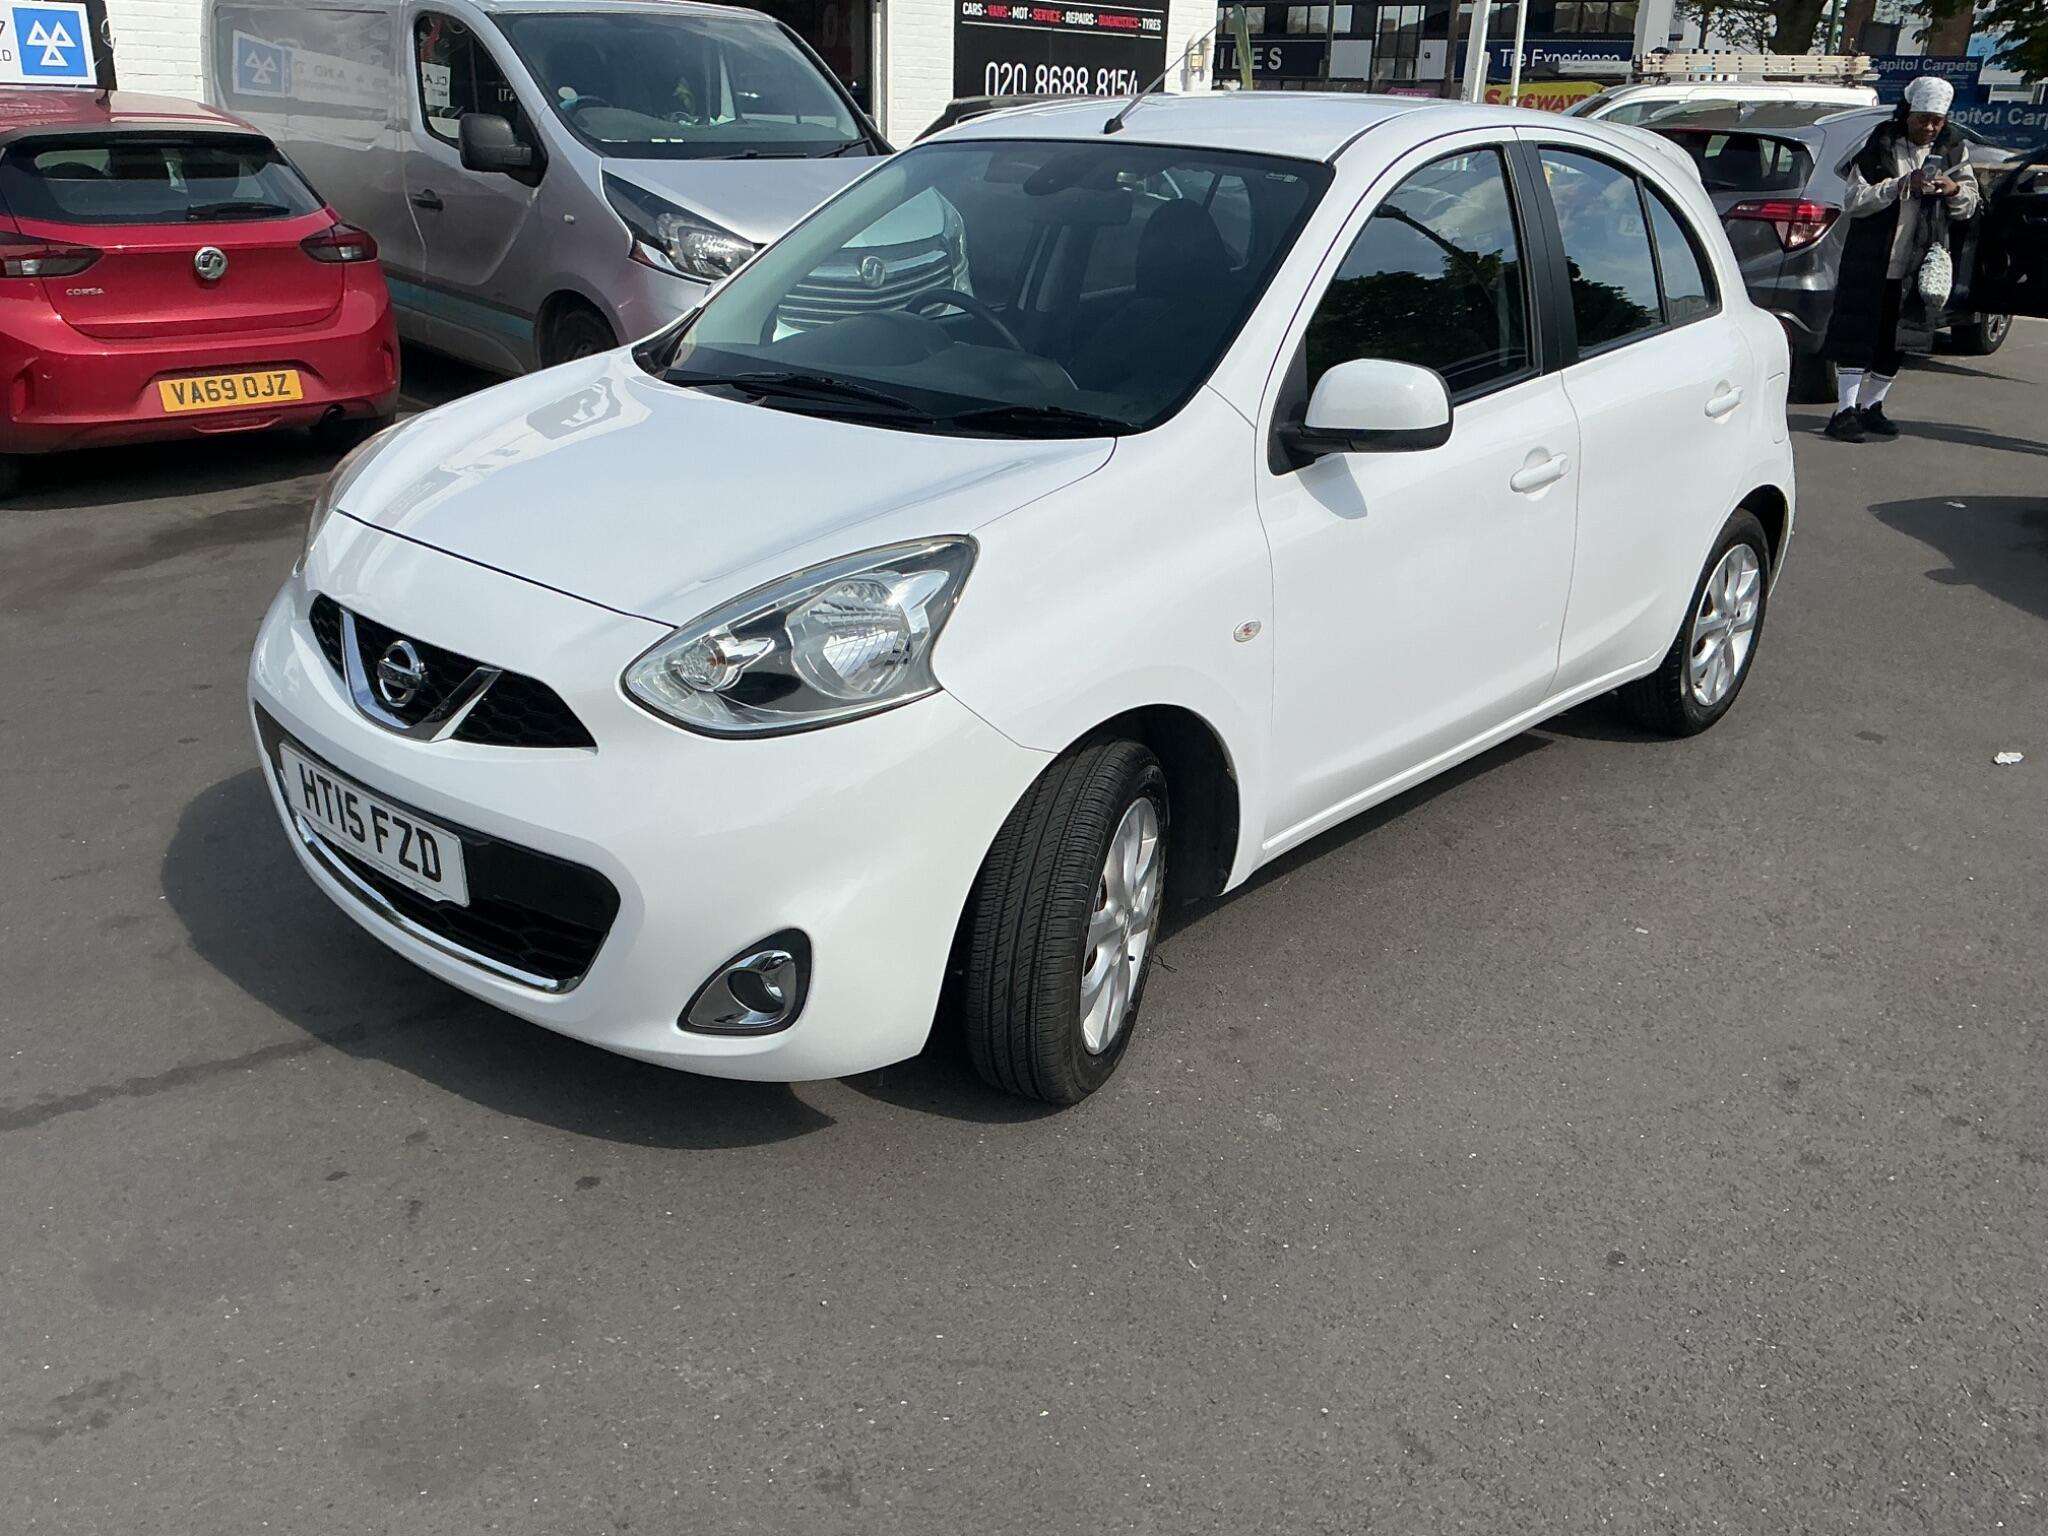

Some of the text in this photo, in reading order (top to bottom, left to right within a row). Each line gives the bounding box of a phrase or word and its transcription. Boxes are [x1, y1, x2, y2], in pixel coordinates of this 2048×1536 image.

[962, 3, 983, 16] CARS
[1012, 7, 1029, 20] MOT
[1033, 8, 1062, 22] SERVICE
[1065, 11, 1094, 25] REPAIRS
[1142, 18, 1162, 31] TYRES
[985, 61, 1138, 96] 020 8688 8154
[1922, 59, 1978, 74] Carpets
[1947, 107, 2001, 125] apitol
[65, 287, 105, 296] CORSA
[171, 373, 291, 405] VA69 OJZ
[299, 763, 442, 883] HT15 FZD
